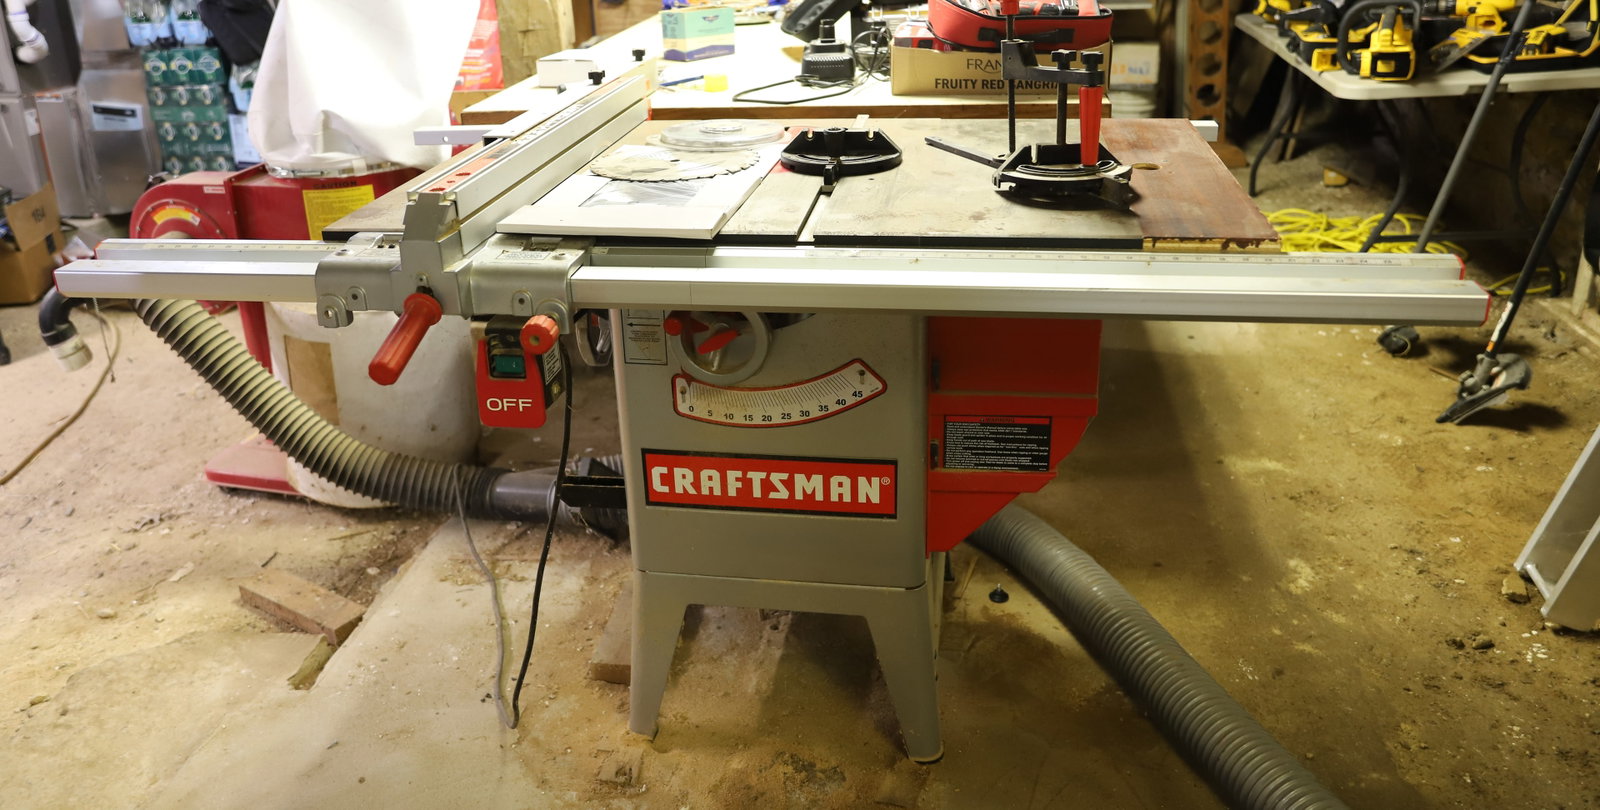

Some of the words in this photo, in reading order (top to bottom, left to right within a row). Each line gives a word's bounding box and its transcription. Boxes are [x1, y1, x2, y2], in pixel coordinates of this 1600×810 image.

[935, 78, 978, 89] FRUITY
[981, 79, 1005, 90] RED
[1013, 79, 1058, 90] ANGRI
[486, 398, 532, 412] OFF
[723, 413, 734, 421] 10
[743, 414, 754, 422] 15
[761, 414, 772, 422] 20
[781, 412, 792, 420] 25
[799, 410, 810, 418] 30
[818, 404, 829, 412] 35
[835, 398, 847, 406] 40
[852, 390, 863, 398] 45
